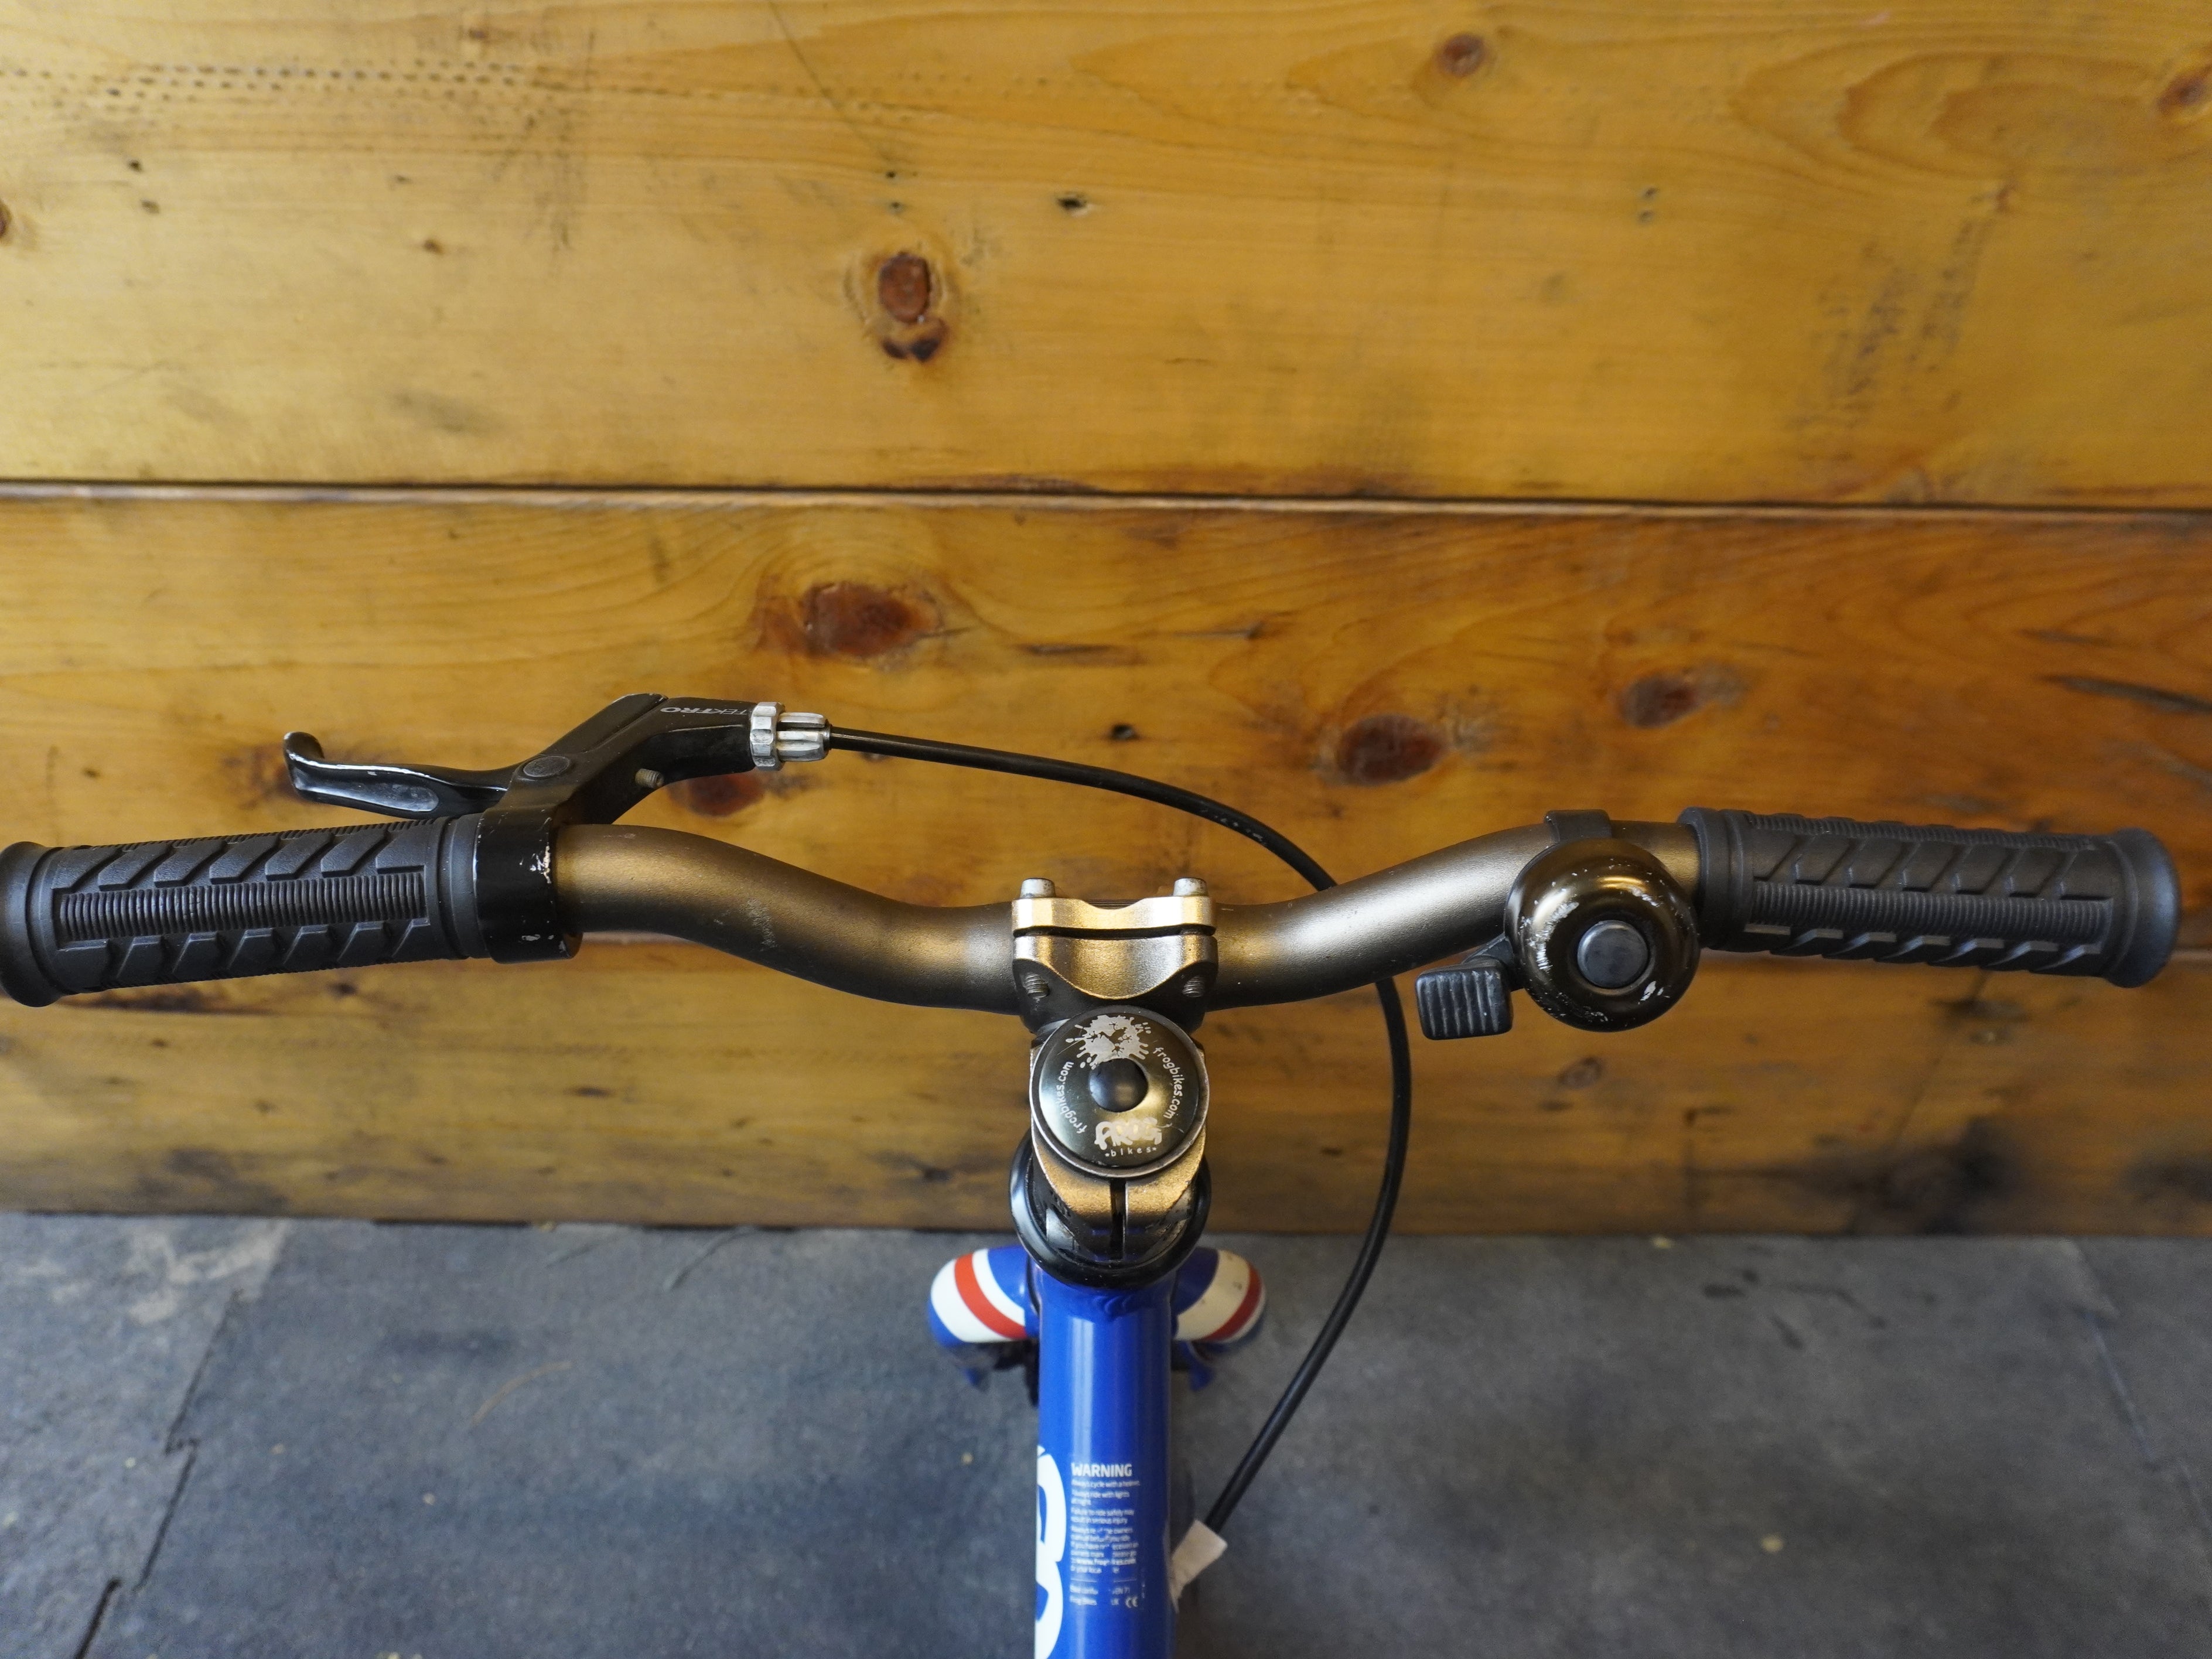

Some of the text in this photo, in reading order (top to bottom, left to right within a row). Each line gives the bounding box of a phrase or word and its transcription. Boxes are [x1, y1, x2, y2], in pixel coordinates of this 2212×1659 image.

[660, 706, 747, 715] TEKTRO
[1055, 1061, 1088, 1134] frogbikes.com
[1152, 1046, 1185, 1120] frogbikes.com
[1071, 1462, 1132, 1477] WARNING
